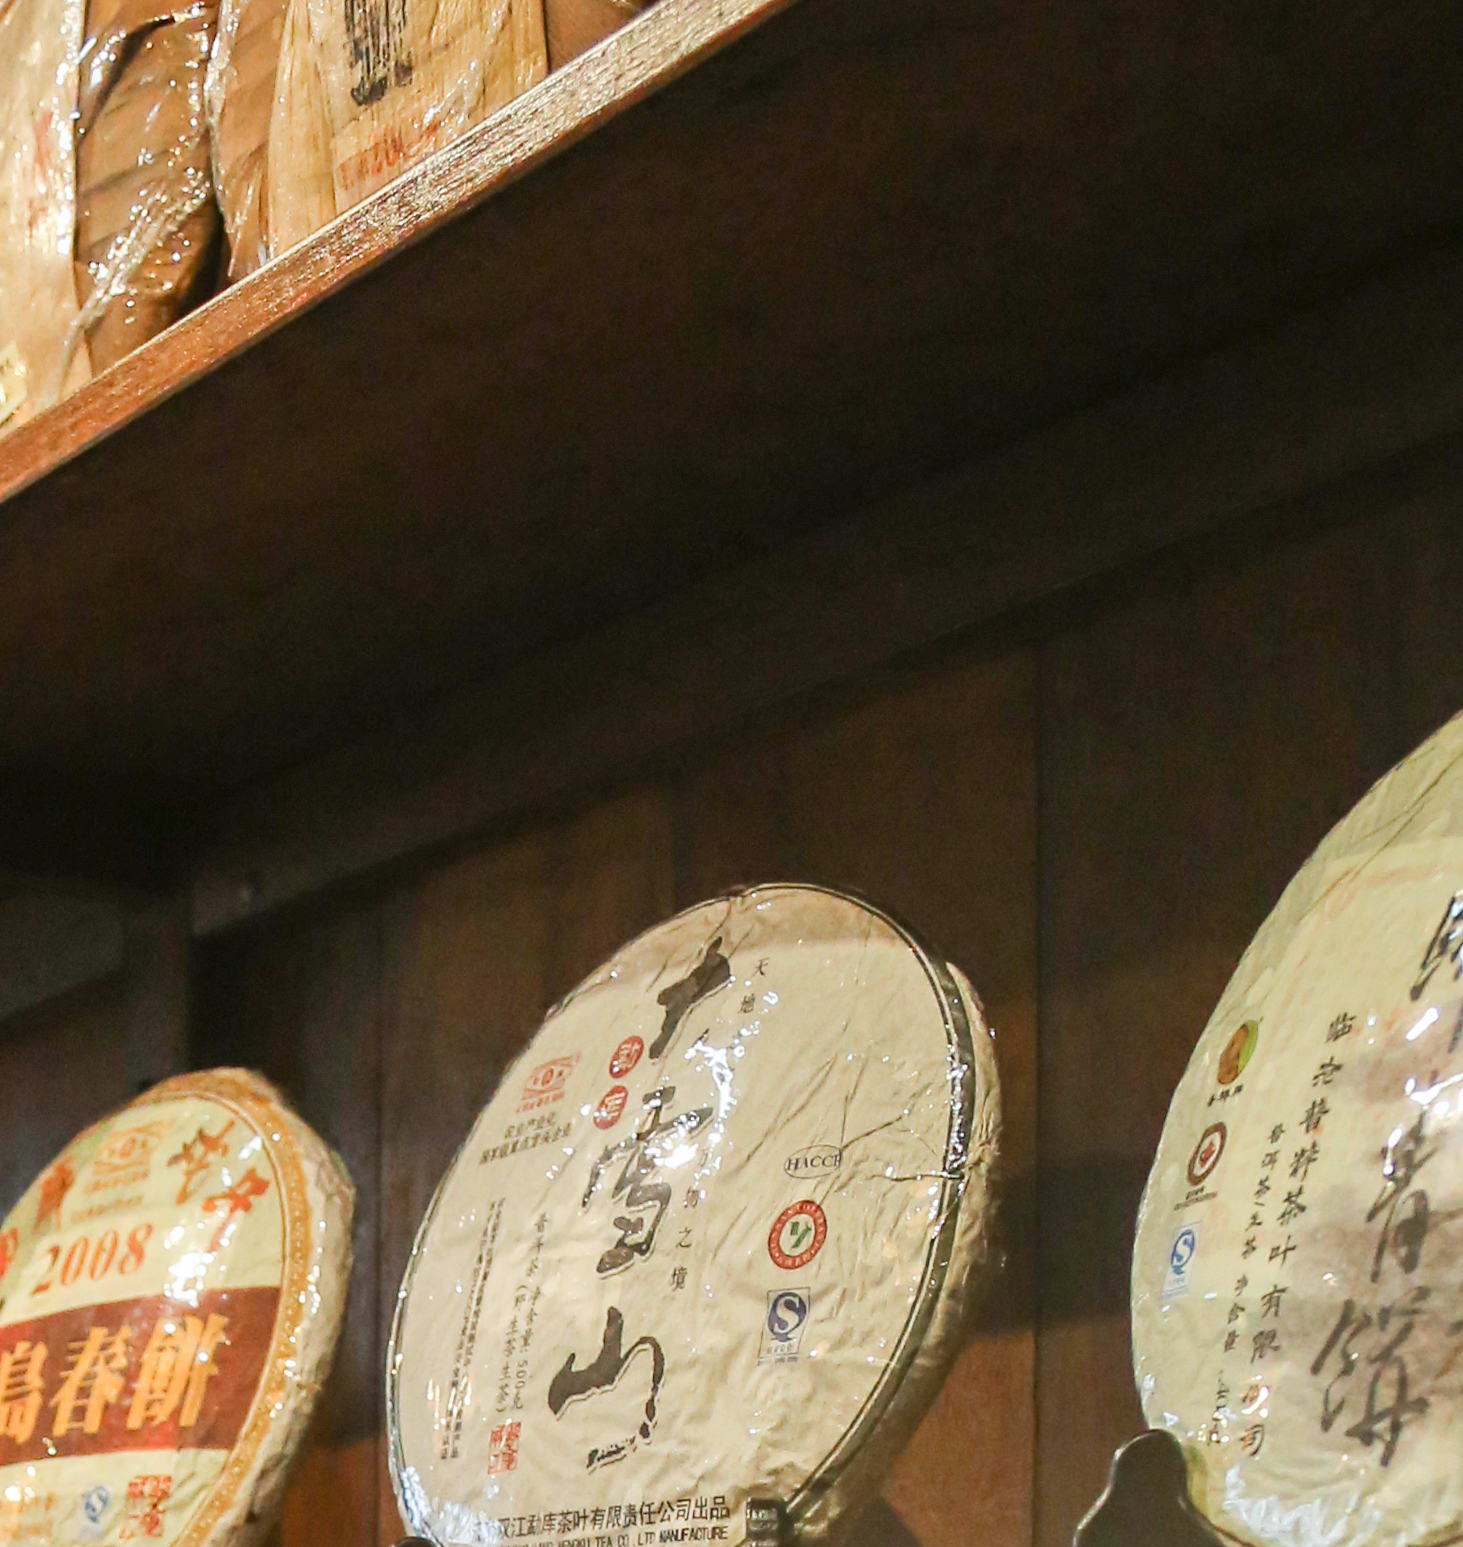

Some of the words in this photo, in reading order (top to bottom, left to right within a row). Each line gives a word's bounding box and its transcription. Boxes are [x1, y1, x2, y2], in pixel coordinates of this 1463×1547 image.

[32, 1222, 153, 1295] 2008
[474, 1495, 730, 1541] 双江勐库茶叶有限责任公司出品
